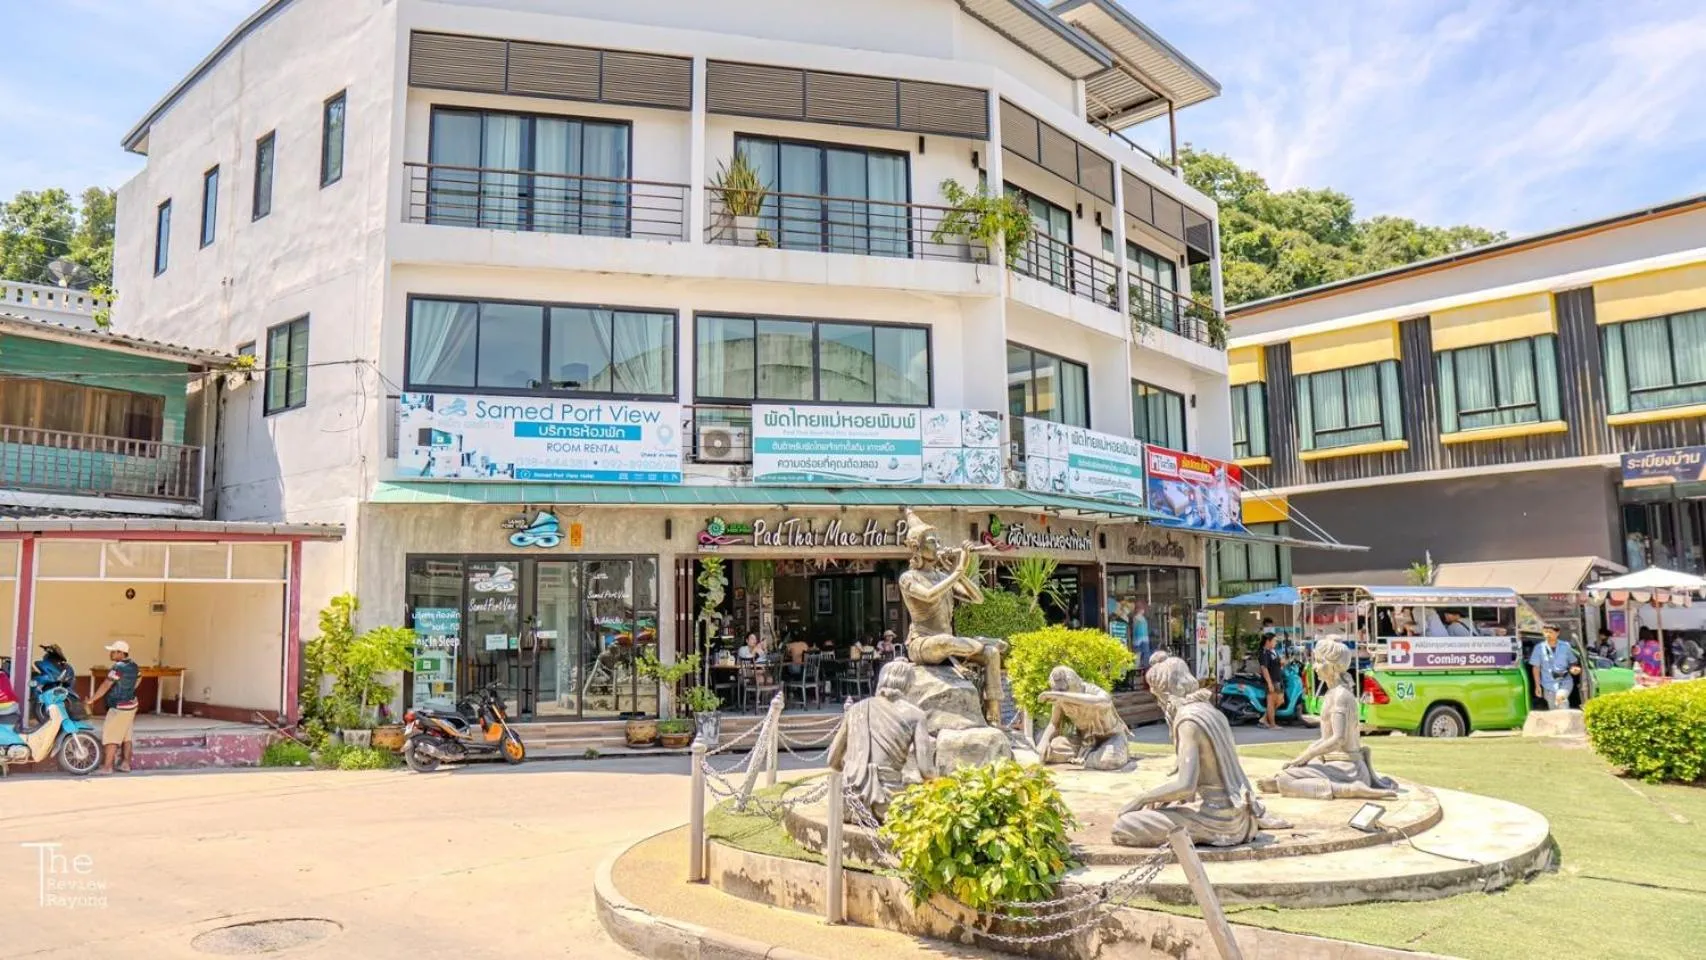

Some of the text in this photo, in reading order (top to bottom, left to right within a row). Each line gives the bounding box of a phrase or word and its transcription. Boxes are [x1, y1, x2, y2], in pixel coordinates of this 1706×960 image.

[475, 400, 661, 424] Samed Port View
[538, 423, 626, 439] บริการห้องพัก
[547, 443, 620, 454] ROOM RENTAL
[1627, 450, 1701, 469] ระเบียงบ้าน
[753, 519, 783, 547] Pad
[784, 518, 819, 548] Thai
[823, 519, 858, 547] Mae
[863, 519, 888, 547] Hoi
[1426, 654, 1496, 665] Coming Soon
[1396, 682, 1415, 699] 54
